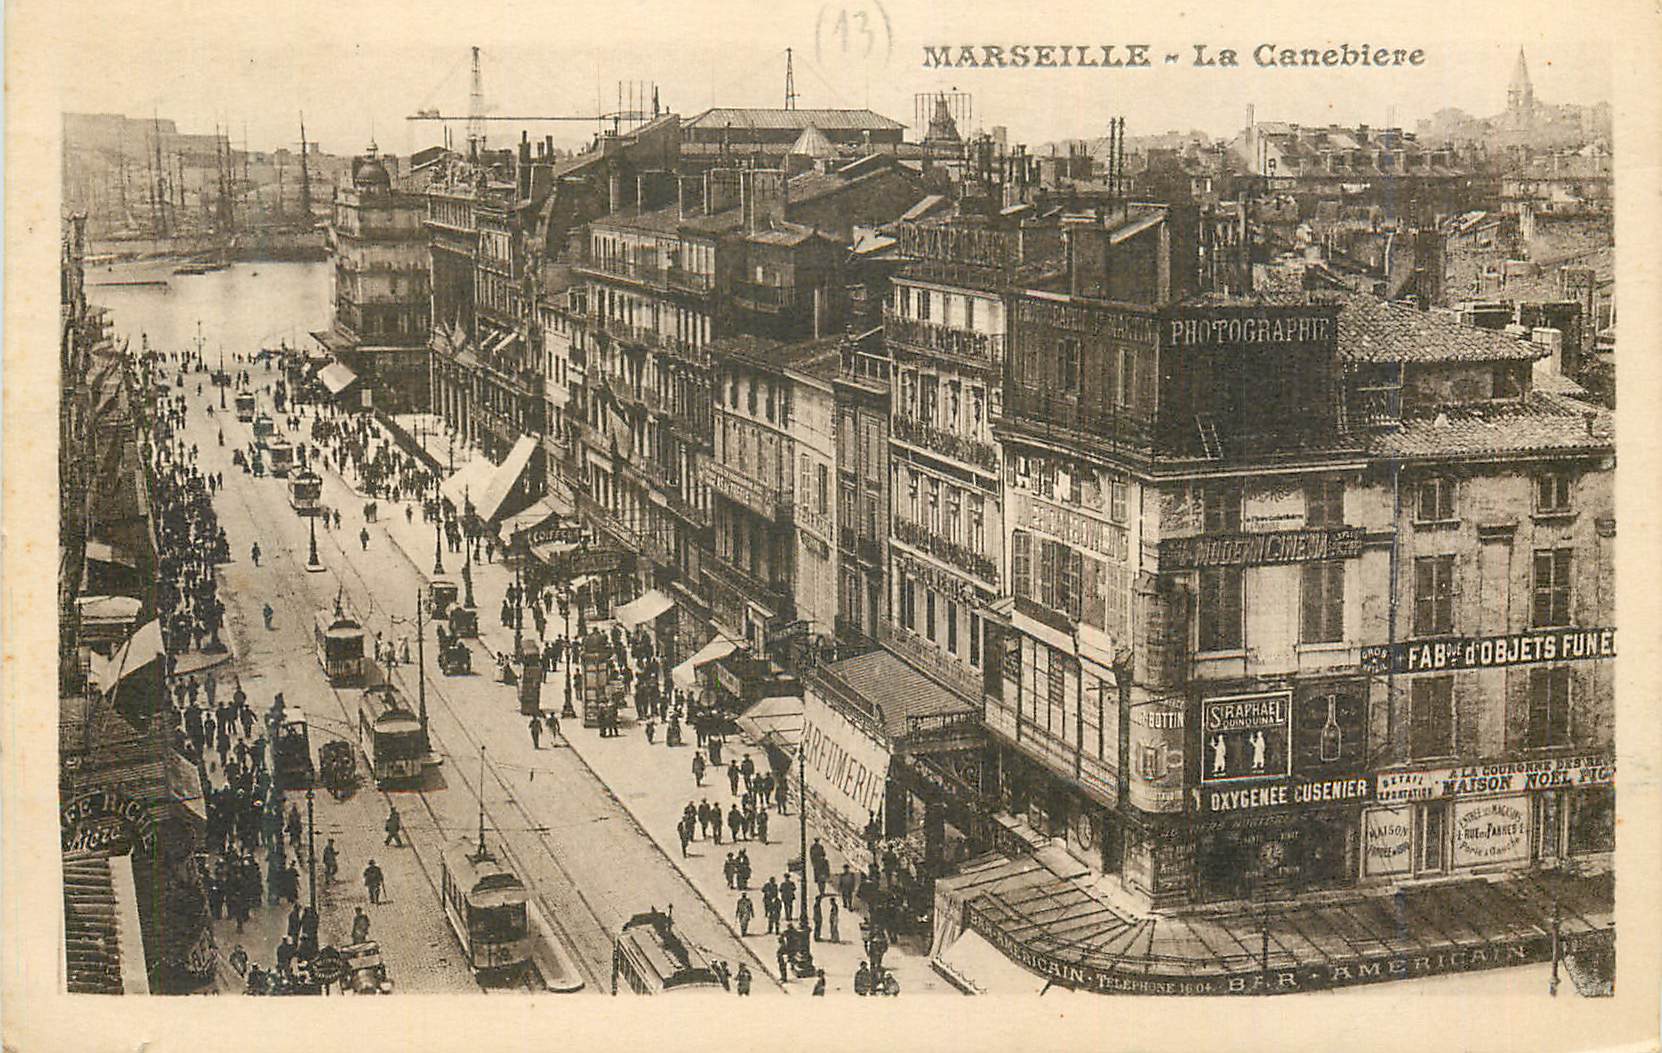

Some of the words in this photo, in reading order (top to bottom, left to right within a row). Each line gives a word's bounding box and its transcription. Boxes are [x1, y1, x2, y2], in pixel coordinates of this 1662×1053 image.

[1171, 317, 1330, 346] PHOTOGRAPHIE
[1465, 634, 1556, 665] d'OBJETS
[1223, 714, 1275, 731] QUINQUINA
[1224, 700, 1285, 723] RAPHAEL
[801, 718, 882, 811] PARFUMERIE
[1295, 779, 1367, 803] CUSENIER
[1442, 775, 1512, 796] MAISON
[1228, 972, 1298, 992] BAR
[1333, 946, 1528, 981] AMERICAIN
